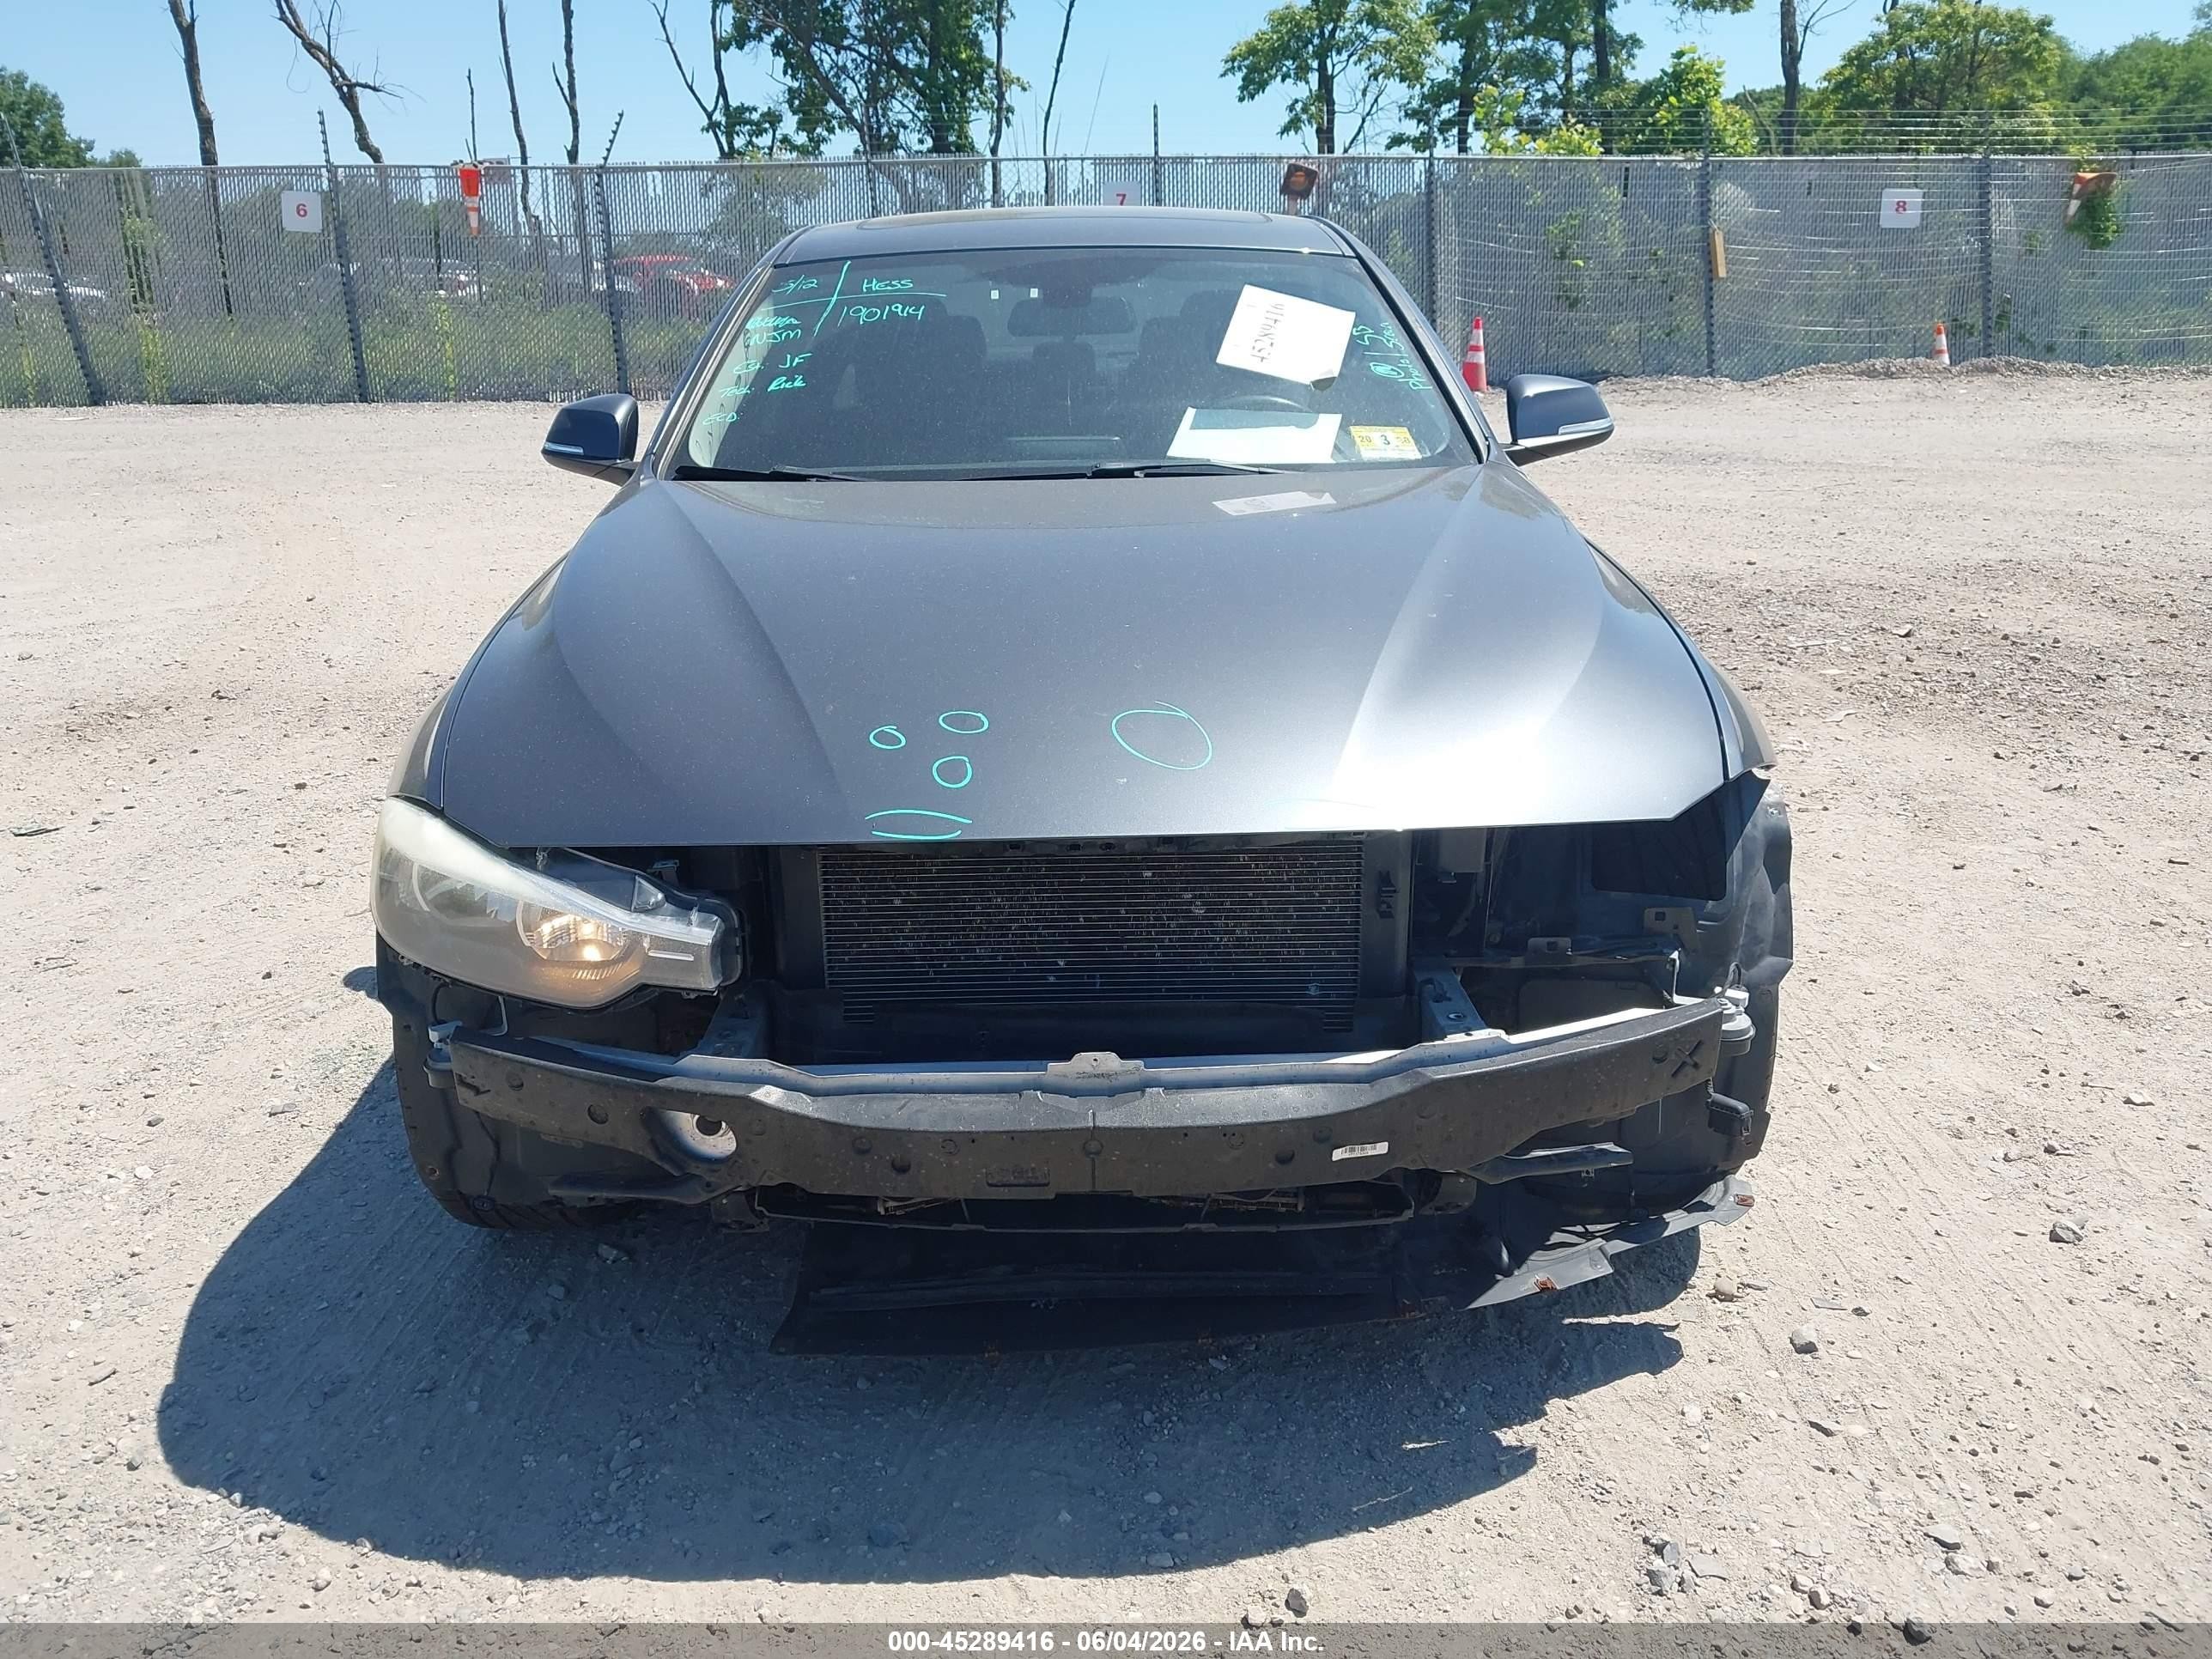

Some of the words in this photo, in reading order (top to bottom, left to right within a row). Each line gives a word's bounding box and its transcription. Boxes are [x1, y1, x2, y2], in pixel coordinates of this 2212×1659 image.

[1115, 193, 1127, 206] 7
[295, 203, 307, 217] 6
[1895, 200, 1907, 215] 8
[837, 303, 926, 327] 1901914
[1380, 434, 1391, 446] 3
